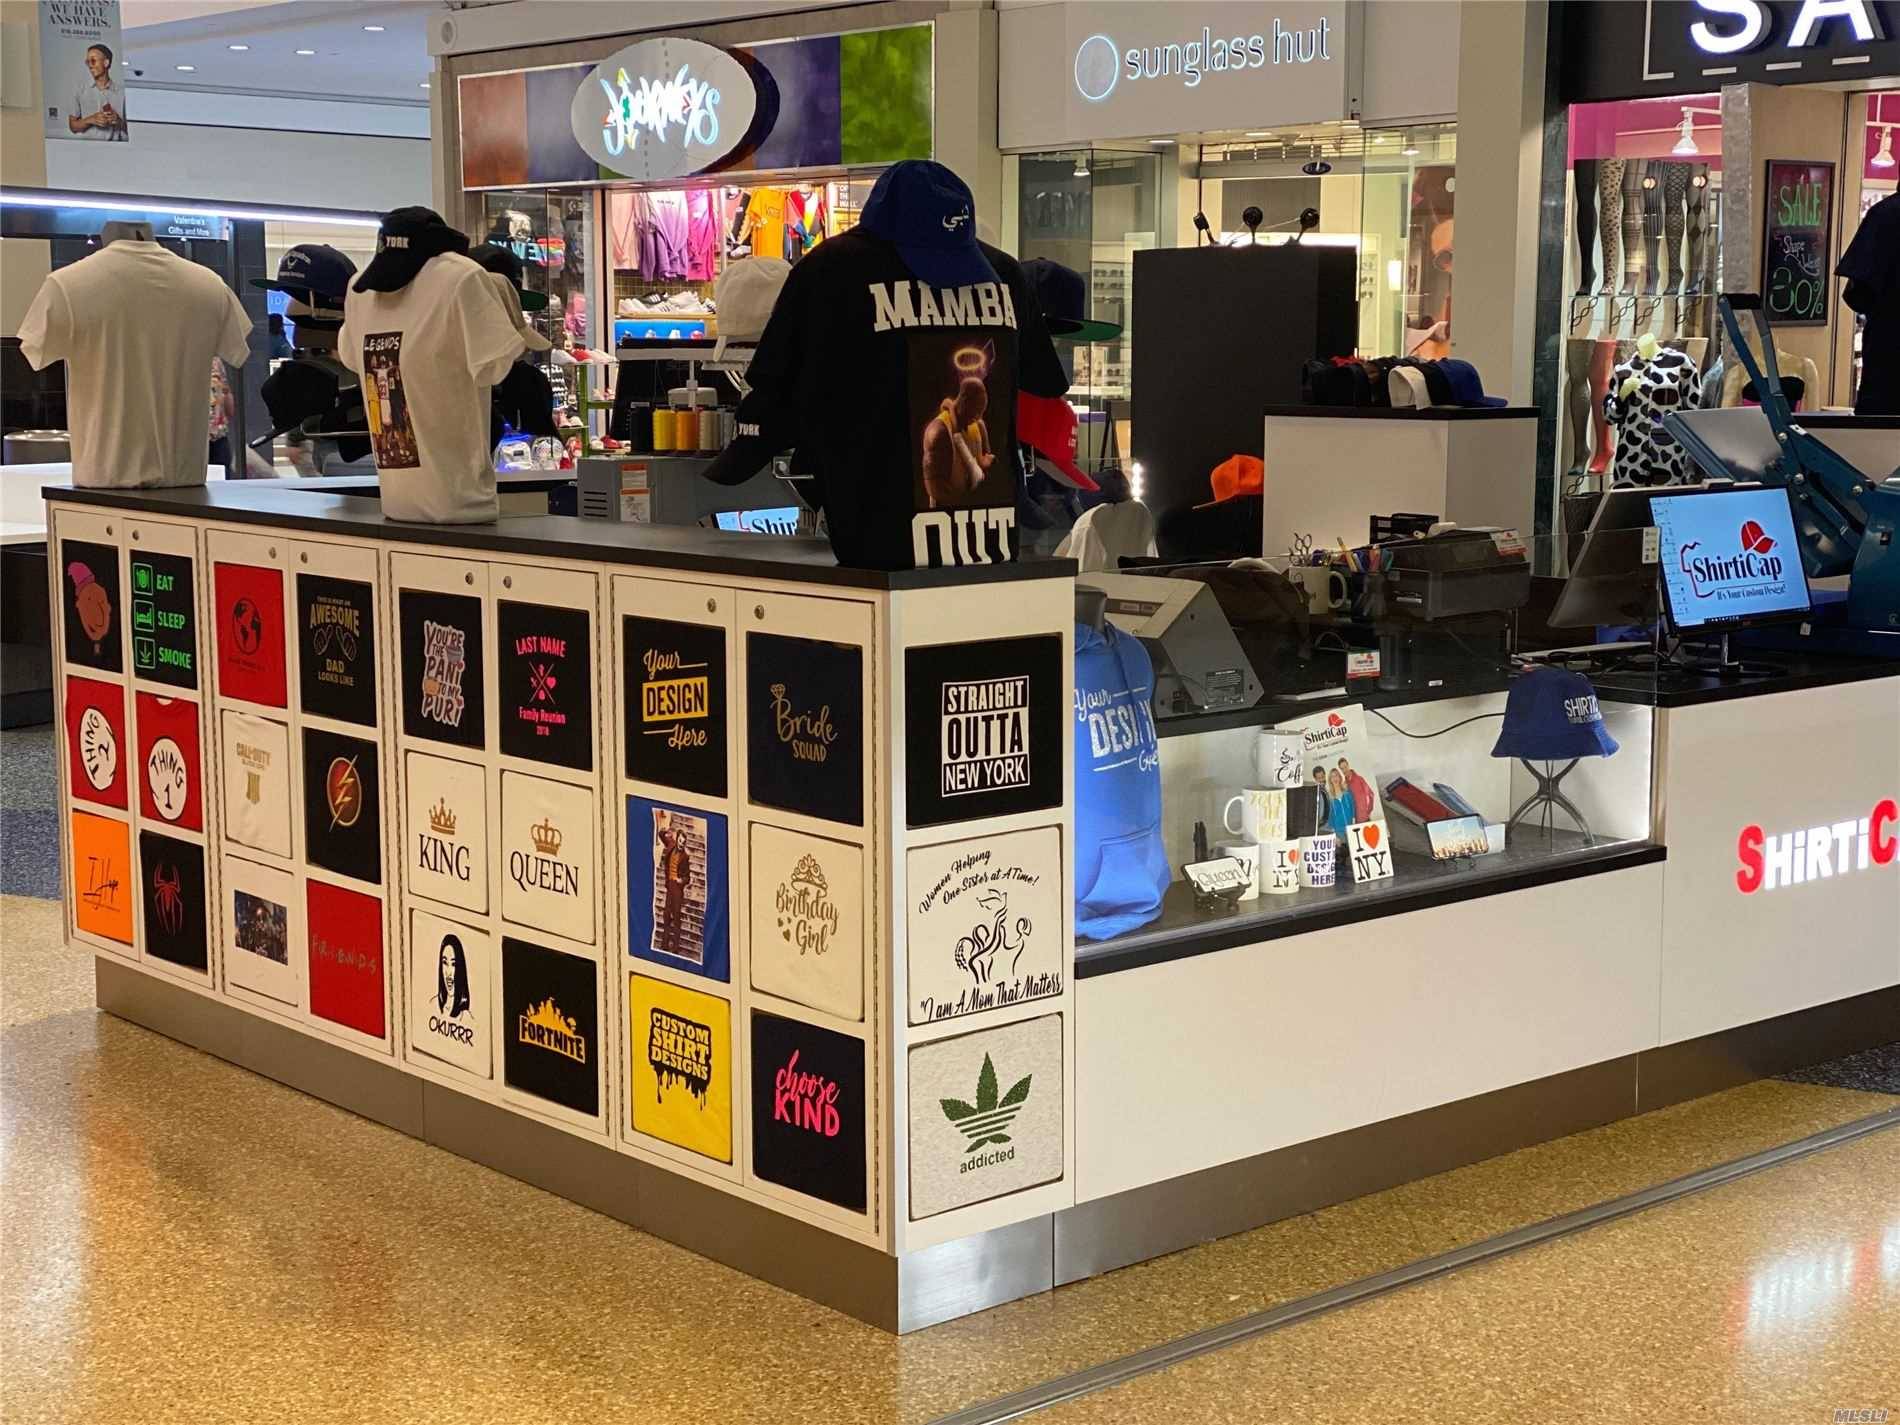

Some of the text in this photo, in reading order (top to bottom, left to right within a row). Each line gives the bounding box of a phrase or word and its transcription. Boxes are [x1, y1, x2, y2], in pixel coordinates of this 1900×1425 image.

[1126, 17, 1330, 87] sunglass hut
[1777, 184, 1822, 226] SALE
[868, 280, 1018, 332] MAMBA
[1770, 266, 1825, 318] 30%
[752, 517, 799, 535] Shir
[911, 506, 1015, 568] OUT
[156, 574, 174, 591] EAT
[1693, 552, 1783, 583] ShirtiCap
[157, 611, 185, 629] SLEEP
[310, 603, 360, 638] AWESOME
[158, 647, 192, 669] SMOKE
[516, 636, 567, 657] LAST NAME
[643, 648, 684, 679] Your
[326, 658, 344, 673] DAD
[646, 681, 705, 716] DESIGN
[947, 681, 1024, 713] STRAIGHT
[1074, 688, 1111, 721] Your
[519, 706, 567, 725] Family Reunion
[769, 698, 839, 745] Bride
[85, 712, 101, 780] THING
[98, 743, 111, 761] 2
[667, 723, 708, 750] Here
[792, 740, 828, 763] SQUAD
[947, 711, 1024, 761] OUTTA
[1305, 726, 1348, 744] ShirtiCap
[150, 749, 185, 790] THING
[945, 756, 1026, 791] NEW YORK
[165, 784, 173, 810] 1
[1352, 827, 1364, 852] I
[1736, 799, 1900, 893] SHiRTiC
[418, 833, 471, 882] KING
[510, 850, 579, 897] QUEEN
[1277, 850, 1286, 868] I
[1354, 850, 1387, 880] NY
[919, 850, 991, 914] Women Helping
[943, 888, 961, 905] One
[962, 875, 989, 892] Sister
[990, 868, 1002, 882] at
[1002, 866, 1012, 880] A
[775, 882, 840, 936] Birthday
[795, 920, 829, 956] Girl
[936, 1001, 952, 1018] am
[954, 990, 966, 1014] A
[966, 987, 994, 1013] Mom
[996, 980, 1021, 1005] That
[428, 1015, 475, 1047] OKURRR
[521, 1018, 584, 1060] FORTNITE
[652, 1011, 709, 1043] CUSTOM
[651, 1045, 709, 1081] DESIGNS
[652, 1028, 709, 1065] SHIRT
[776, 1050, 840, 1105] choose
[775, 1089, 840, 1137] KIND
[959, 1146, 1015, 1174] addicted
